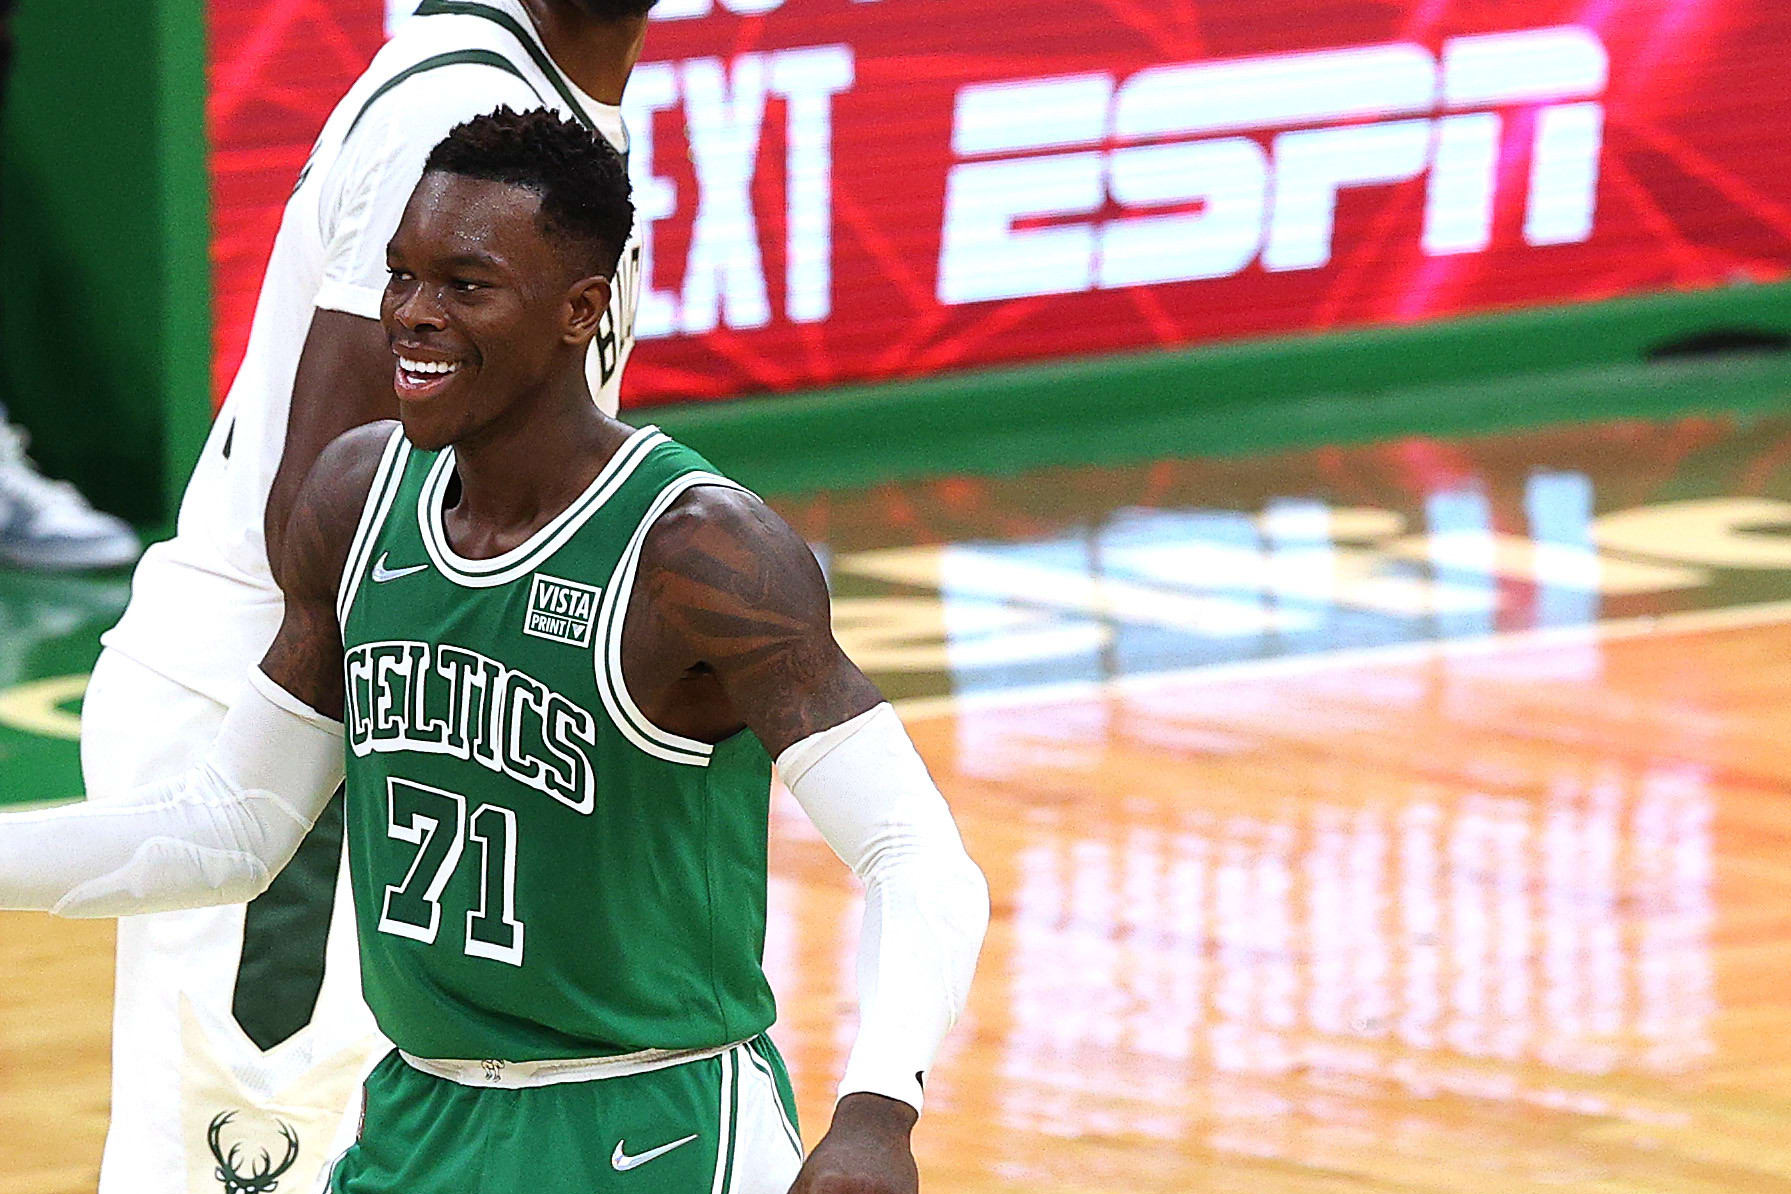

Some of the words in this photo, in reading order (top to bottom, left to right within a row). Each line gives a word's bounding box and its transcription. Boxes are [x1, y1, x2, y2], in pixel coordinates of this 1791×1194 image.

[619, 43, 855, 339] EXT
[937, 25, 1609, 305] ESPN
[530, 613, 567, 636] PRINT
[539, 582, 590, 619] VISTA
[345, 642, 597, 815] CELTICS
[378, 776, 524, 967] 71
